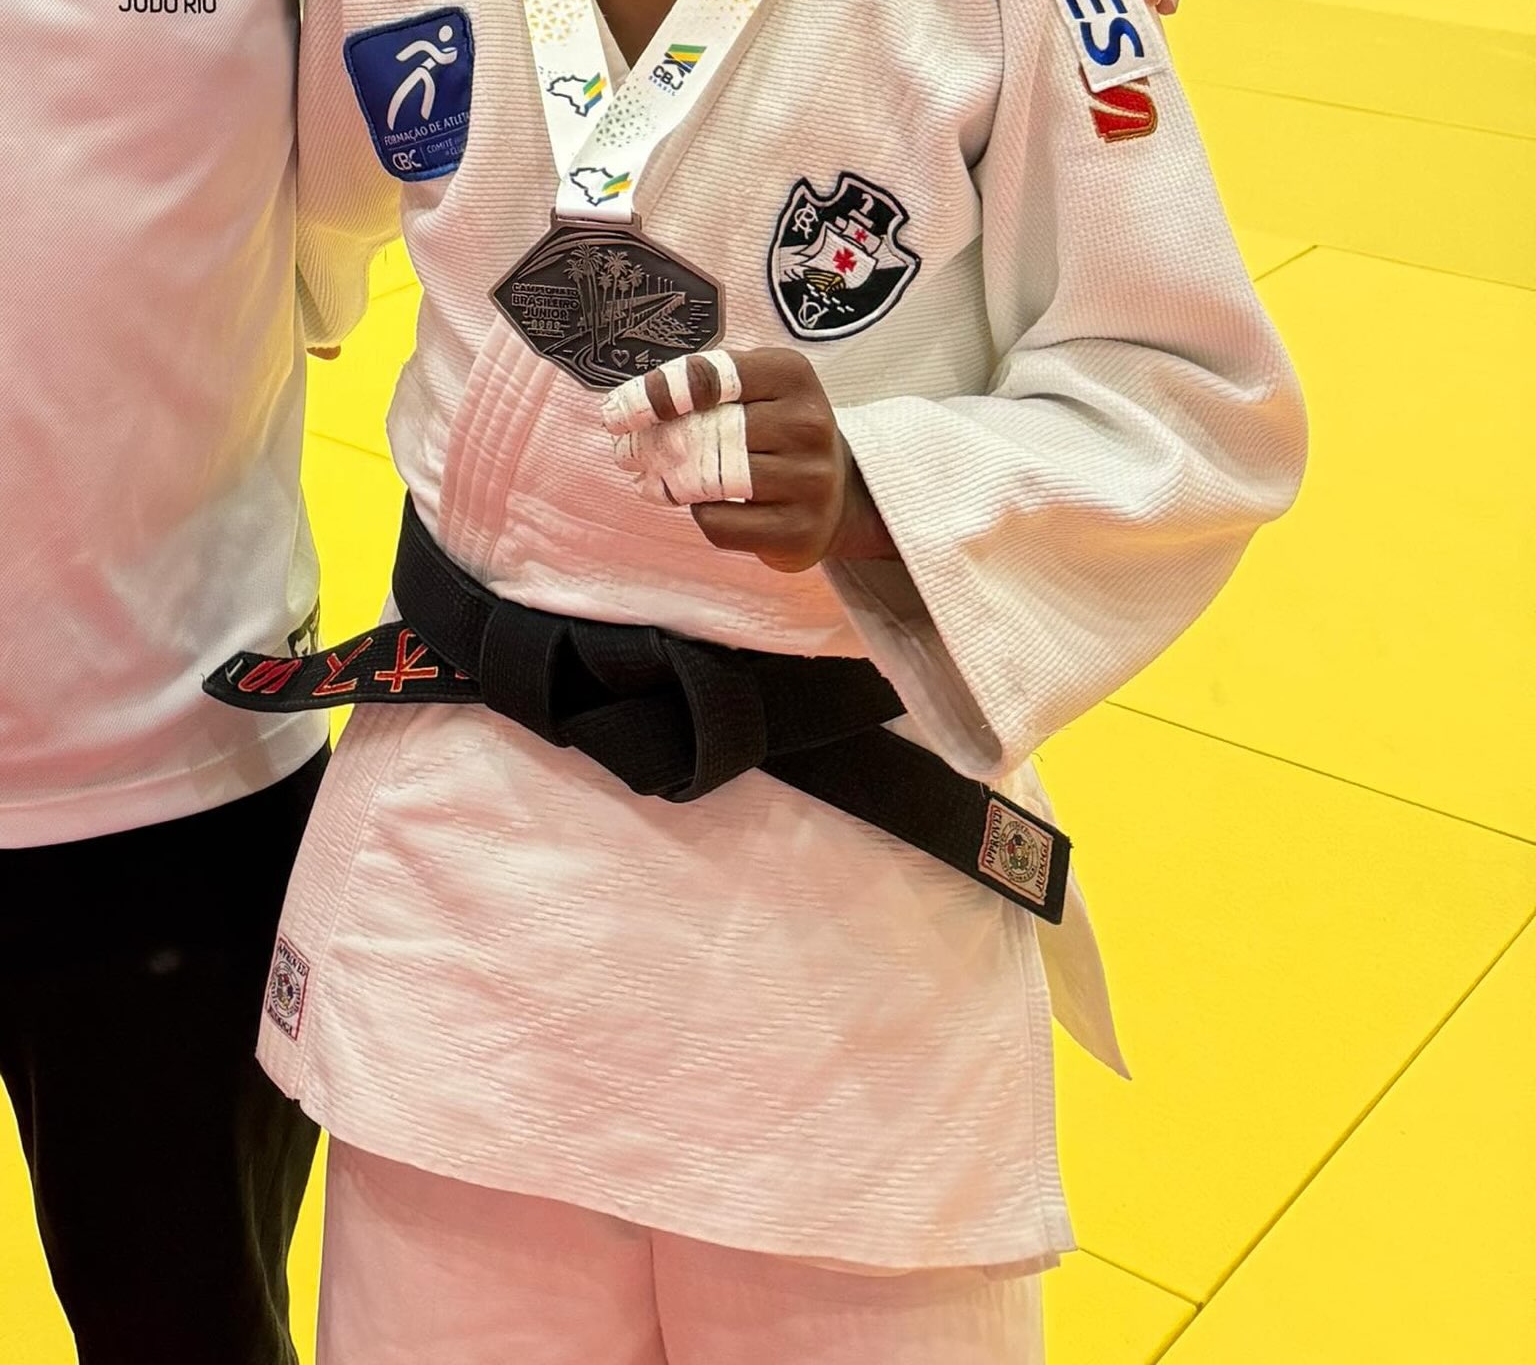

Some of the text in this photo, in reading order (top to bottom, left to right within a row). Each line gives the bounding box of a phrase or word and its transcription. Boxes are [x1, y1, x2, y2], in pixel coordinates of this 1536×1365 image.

[653, 64, 684, 91] CBJ
[384, 125, 428, 146] FORMAÇÃO
[428, 121, 443, 134] DE
[512, 293, 580, 311] BRASILEIRO
[984, 808, 1003, 869] APPROVED
[1035, 842, 1049, 892] JUDOGI
